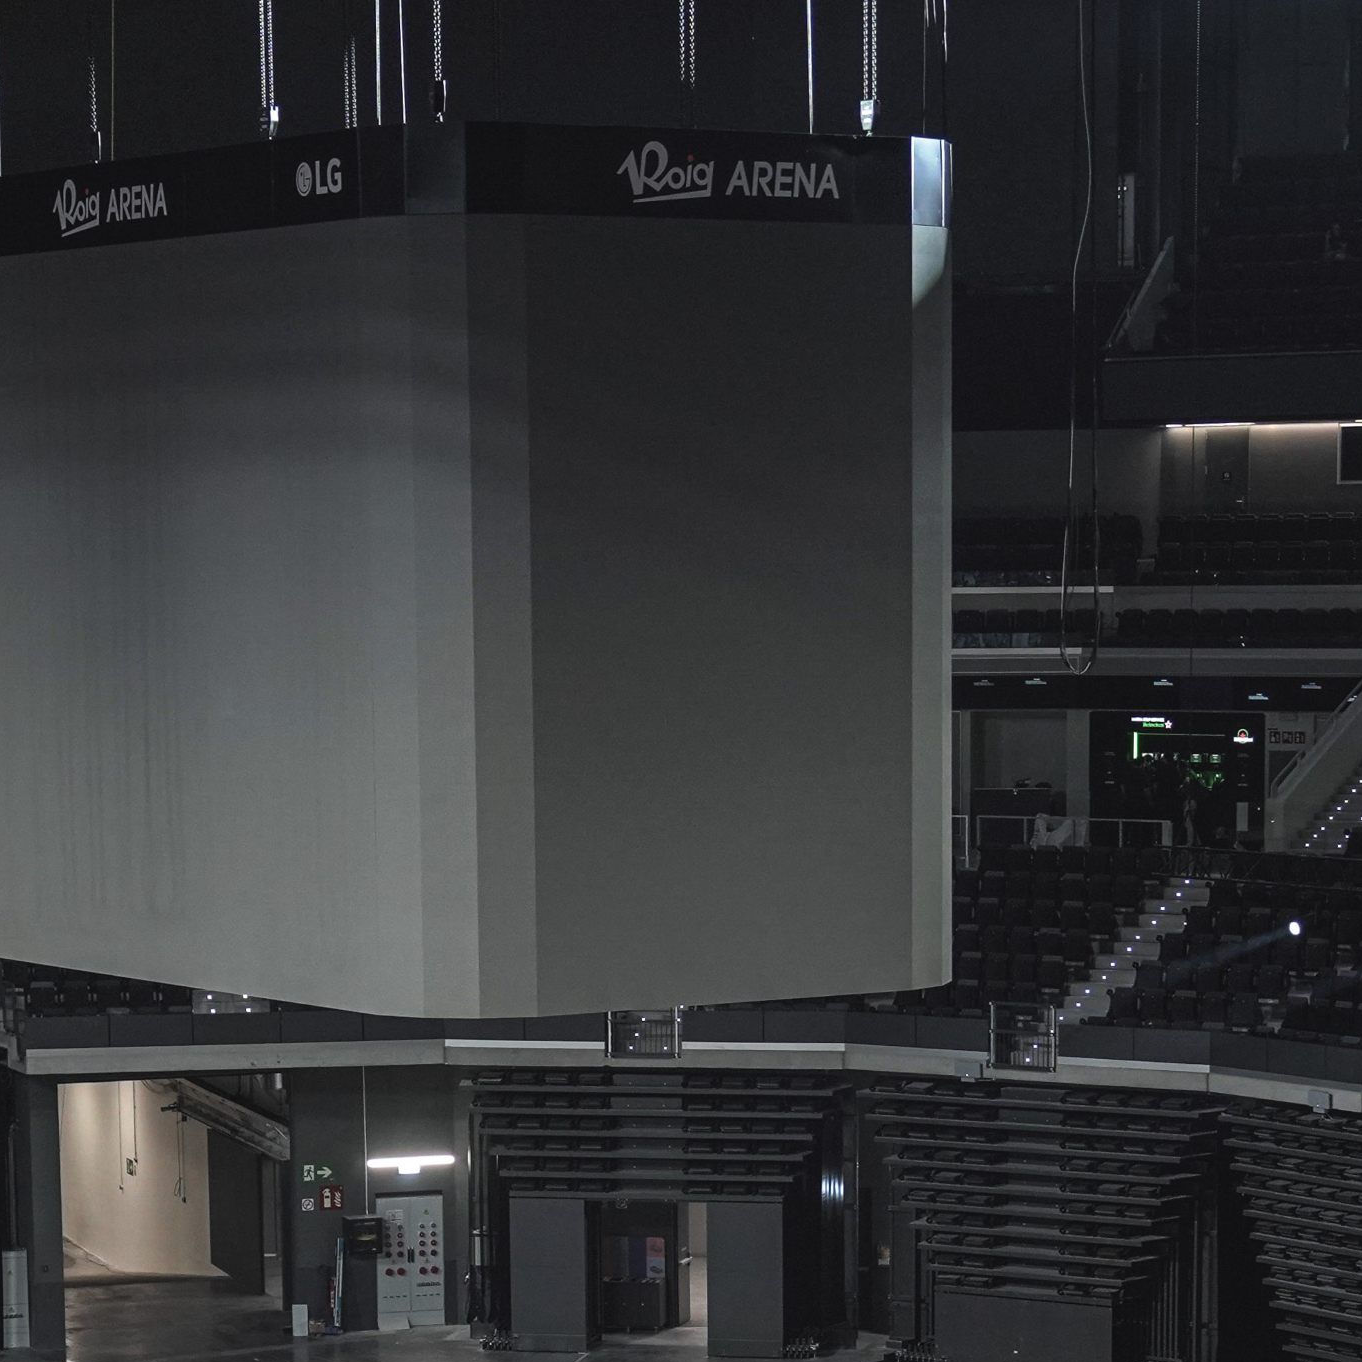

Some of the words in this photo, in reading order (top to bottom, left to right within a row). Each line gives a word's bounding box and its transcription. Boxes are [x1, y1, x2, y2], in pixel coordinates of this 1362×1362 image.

[315, 158, 343, 195] LG
[616, 141, 715, 203] Roig
[725, 160, 840, 199] ARENA
[52, 178, 100, 237] Roig
[106, 182, 168, 223] ARENA
